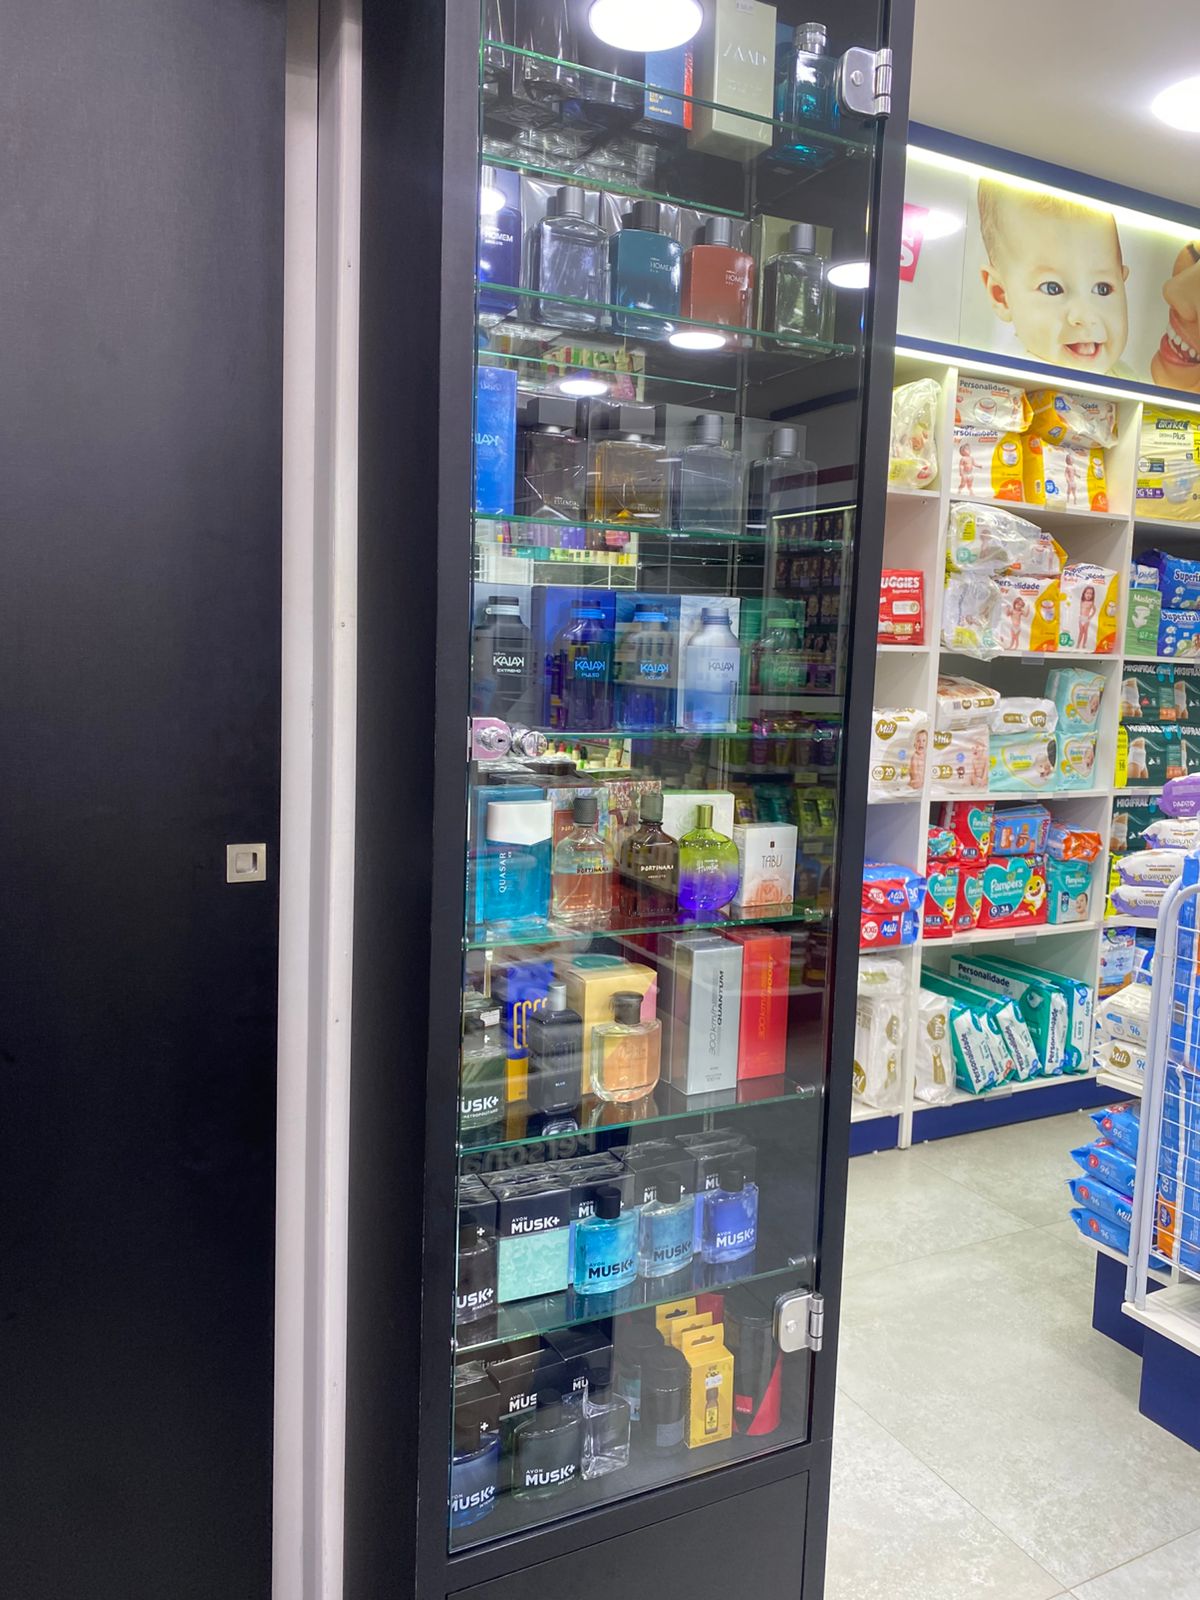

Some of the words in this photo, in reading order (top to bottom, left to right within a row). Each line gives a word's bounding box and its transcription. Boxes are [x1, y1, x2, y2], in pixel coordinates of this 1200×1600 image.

[493, 656, 525, 667] KAIAK
[574, 660, 606, 671] KAIAK
[640, 663, 669, 674] KAIAK
[708, 661, 735, 672] KAIAK
[761, 854, 783, 869] TABU
[498, 852, 507, 894] QUASAR
[990, 879, 1023, 894] Pampers
[1001, 905, 1010, 914] 34
[958, 963, 1010, 988] Personalidade
[717, 970, 725, 1027] QUANTUM
[961, 1032, 982, 1084] Personalidade
[511, 1216, 560, 1235] MUSK+
[716, 1228, 755, 1248] MUSK+
[653, 1241, 692, 1262] MUSK+
[588, 1258, 635, 1280] MUSK+
[525, 1464, 576, 1487] MUSK+
